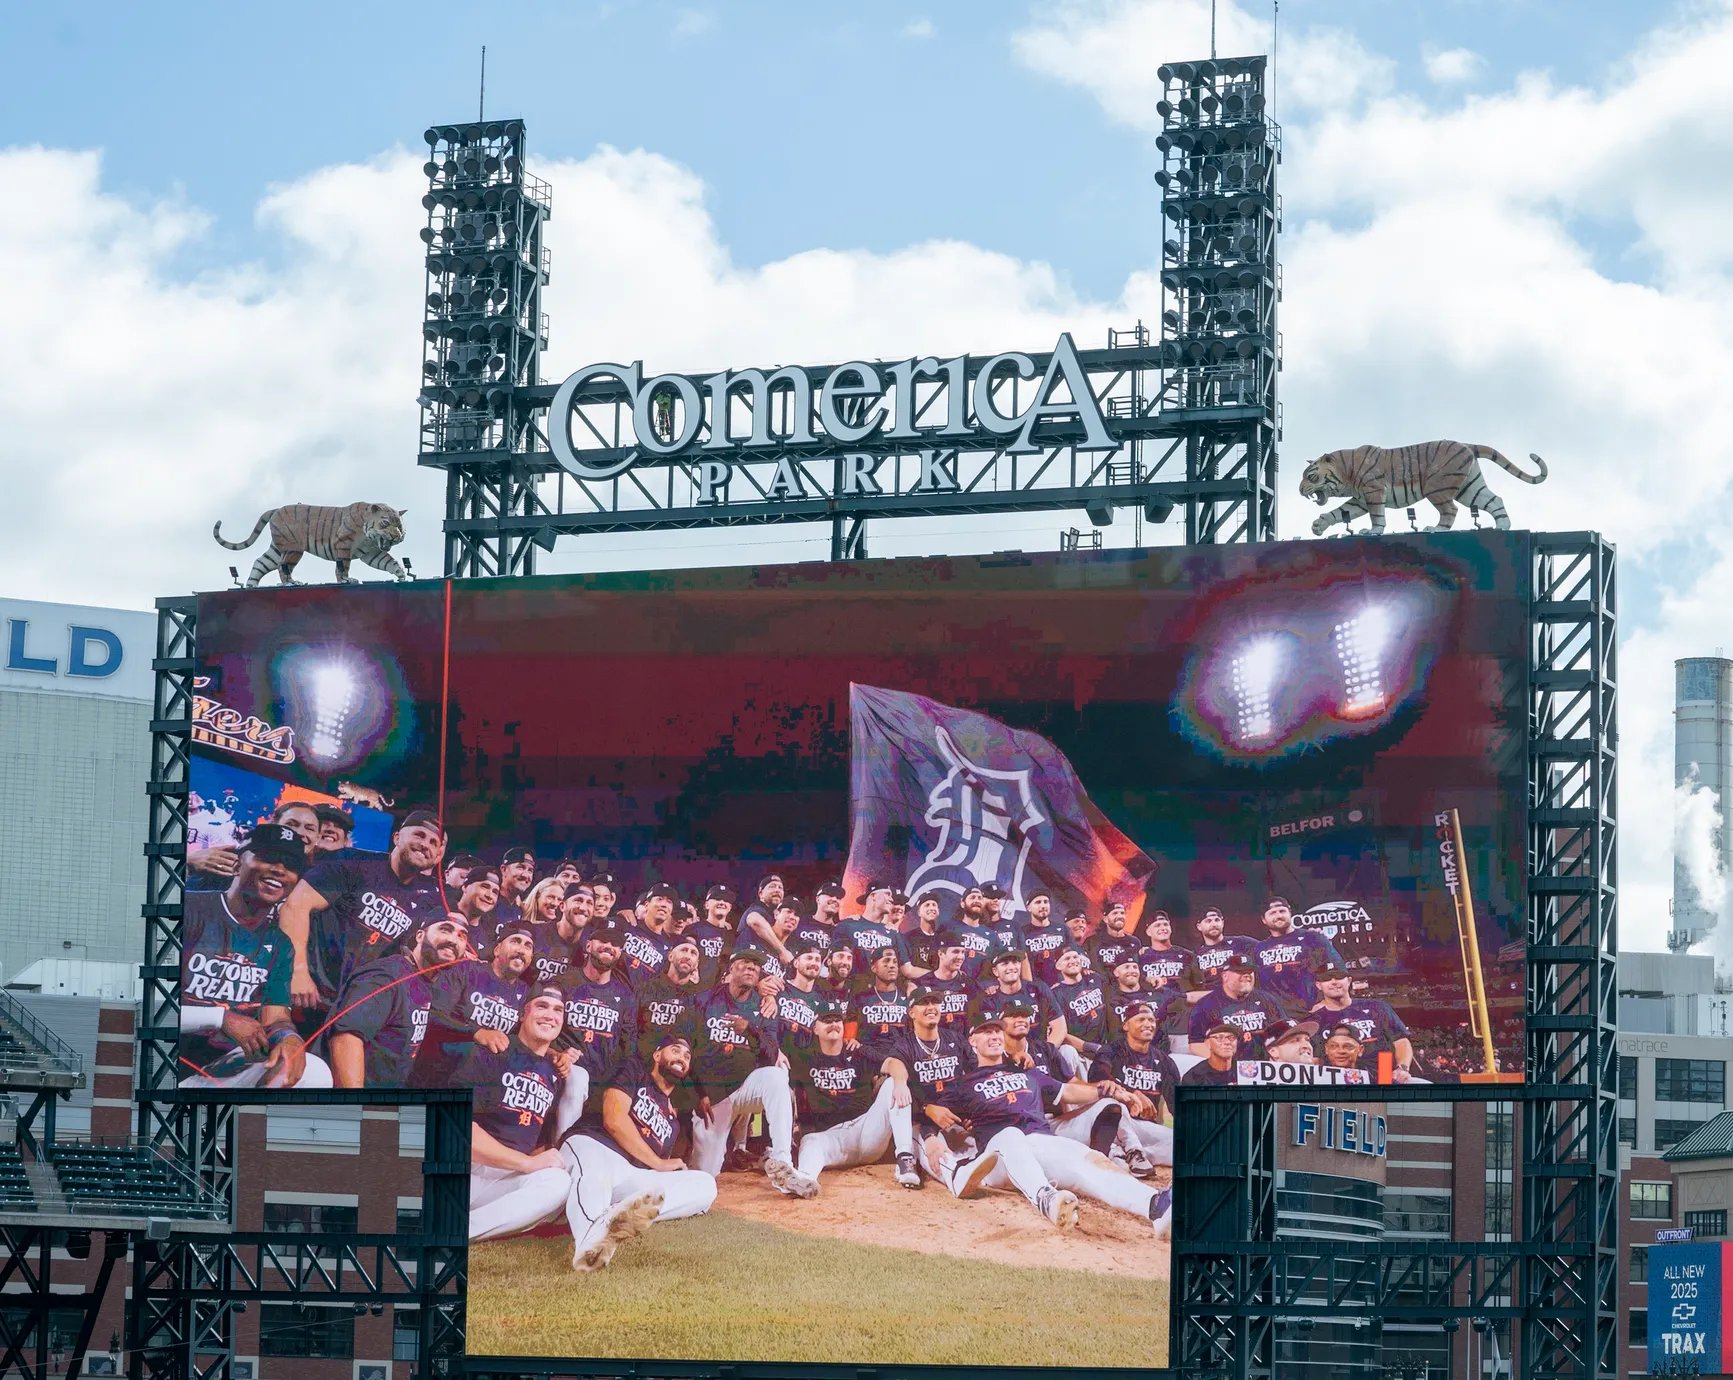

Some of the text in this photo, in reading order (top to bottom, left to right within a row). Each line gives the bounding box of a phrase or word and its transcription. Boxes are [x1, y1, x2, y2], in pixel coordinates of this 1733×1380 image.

[697, 449, 961, 505] PARK
[1270, 816, 1335, 838] BELFOR
[361, 892, 412, 931] OCTOBER
[358, 906, 405, 939] READY
[965, 940, 989, 953] EADY
[1026, 935, 1064, 947] OCTOBER
[1030, 942, 1061, 952] READY
[623, 942, 657, 968] READY
[1259, 946, 1302, 958] OCTOBER
[1263, 953, 1298, 966] READY
[188, 953, 269, 984] OCTOBER
[1143, 961, 1184, 973] OCTOBER
[945, 994, 968, 1003] OBER
[1069, 988, 1103, 1010] OCTOBER
[565, 1001, 620, 1023] OCTOBER
[862, 1005, 908, 1016] OCTOBER
[940, 1003, 966, 1013] EADY
[470, 1006, 516, 1035] READY
[567, 1012, 614, 1033] READY
[651, 1013, 676, 1025] REA
[780, 1007, 814, 1028] READY
[866, 1013, 904, 1025] READY
[914, 1056, 959, 1072] OCTOBER
[809, 1067, 857, 1080] OCTOBER
[919, 1066, 956, 1083] READY
[1261, 1062, 1340, 1085] DON'T
[501, 1071, 555, 1107] OCTOBER
[813, 1077, 853, 1090] READY
[983, 1080, 1028, 1099] READY
[502, 1087, 549, 1118] READY
[1294, 1102, 1388, 1159] FIELD
[1657, 1229, 1691, 1241] OUTFRONT
[1663, 1264, 1706, 1280] ALL NEW
[1671, 1282, 1698, 1299] 2025
[1661, 1332, 1706, 1355] TRAX
